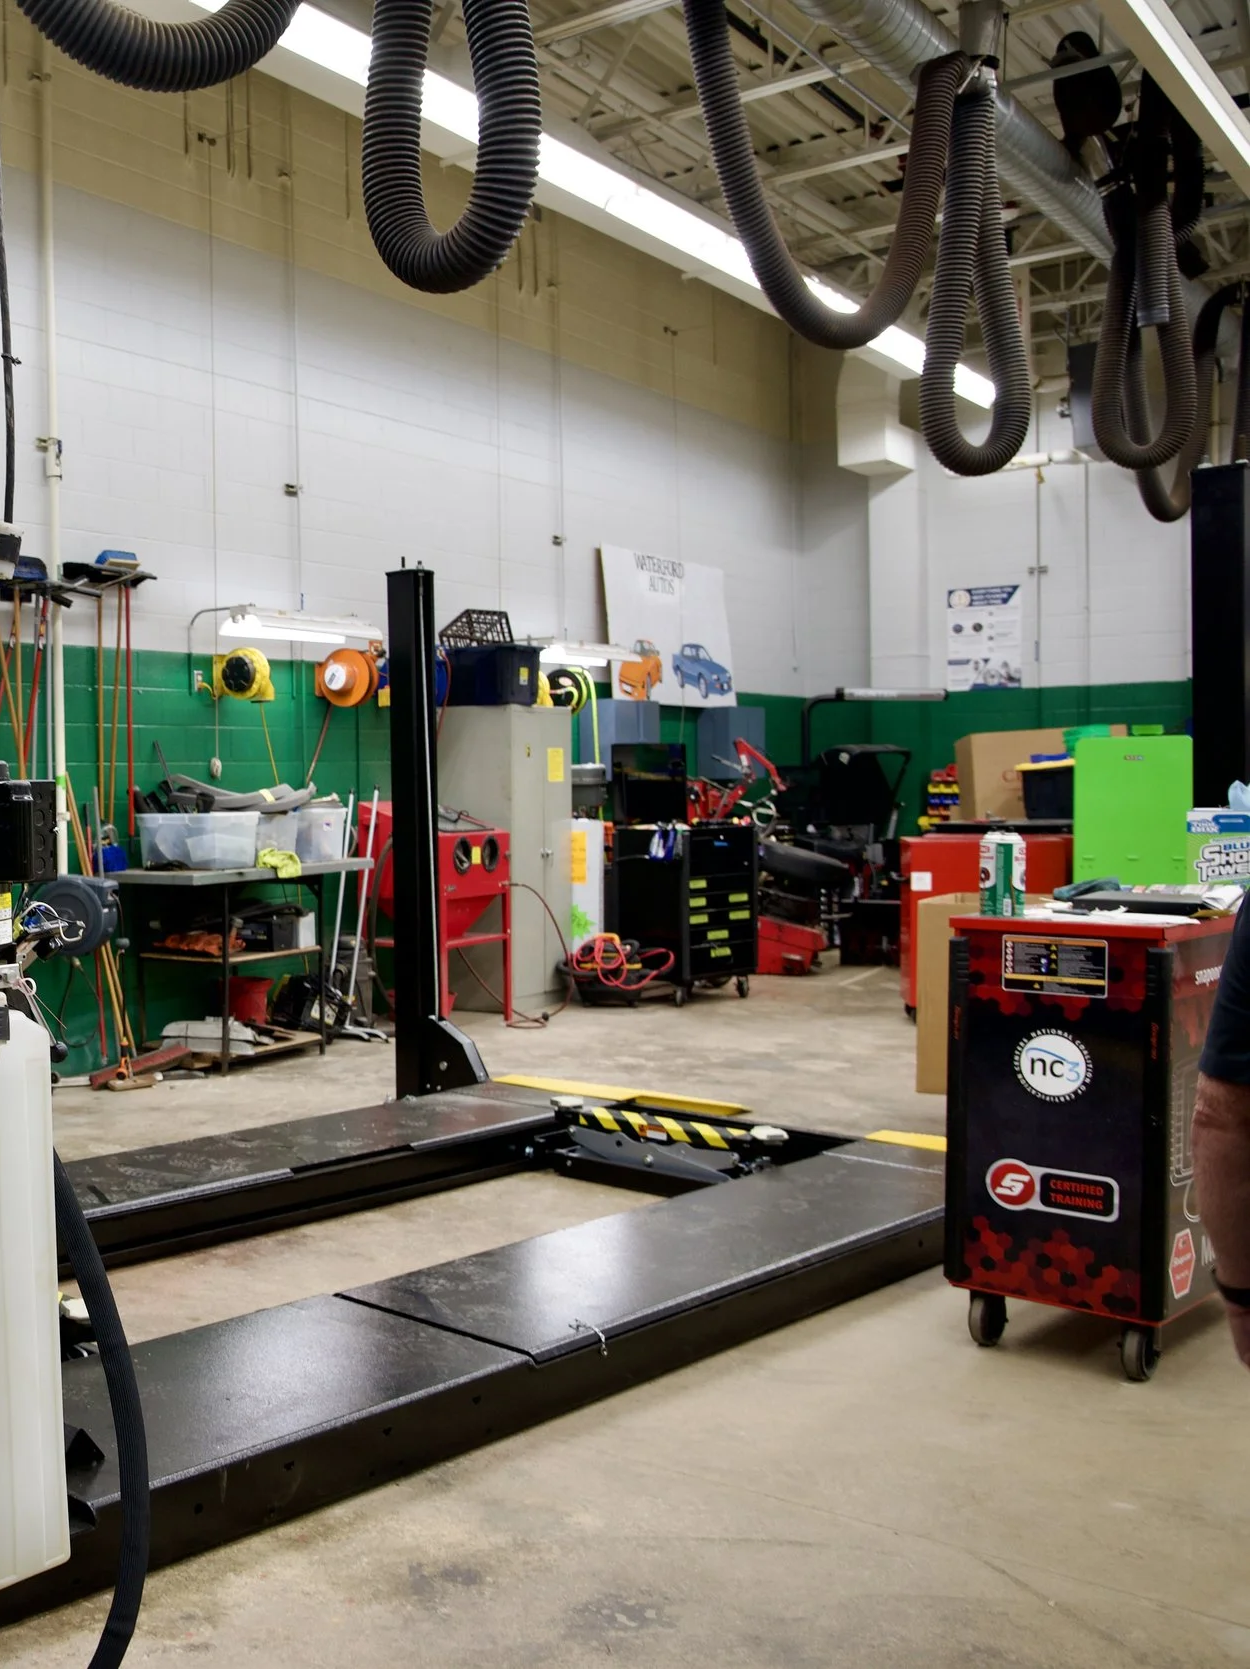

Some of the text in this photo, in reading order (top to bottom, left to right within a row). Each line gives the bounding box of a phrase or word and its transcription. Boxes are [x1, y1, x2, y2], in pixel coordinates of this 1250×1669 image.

[633, 552, 685, 579] WATERFORD
[649, 575, 675, 596] AUTOS
[1202, 845, 1250, 866] SHO
[1196, 862, 1250, 882] TOWE
[1030, 1028, 1073, 1041] NATIONAL
[1049, 1179, 1104, 1196] CERTIFIED
[1049, 1192, 1104, 1210] TRAINING
